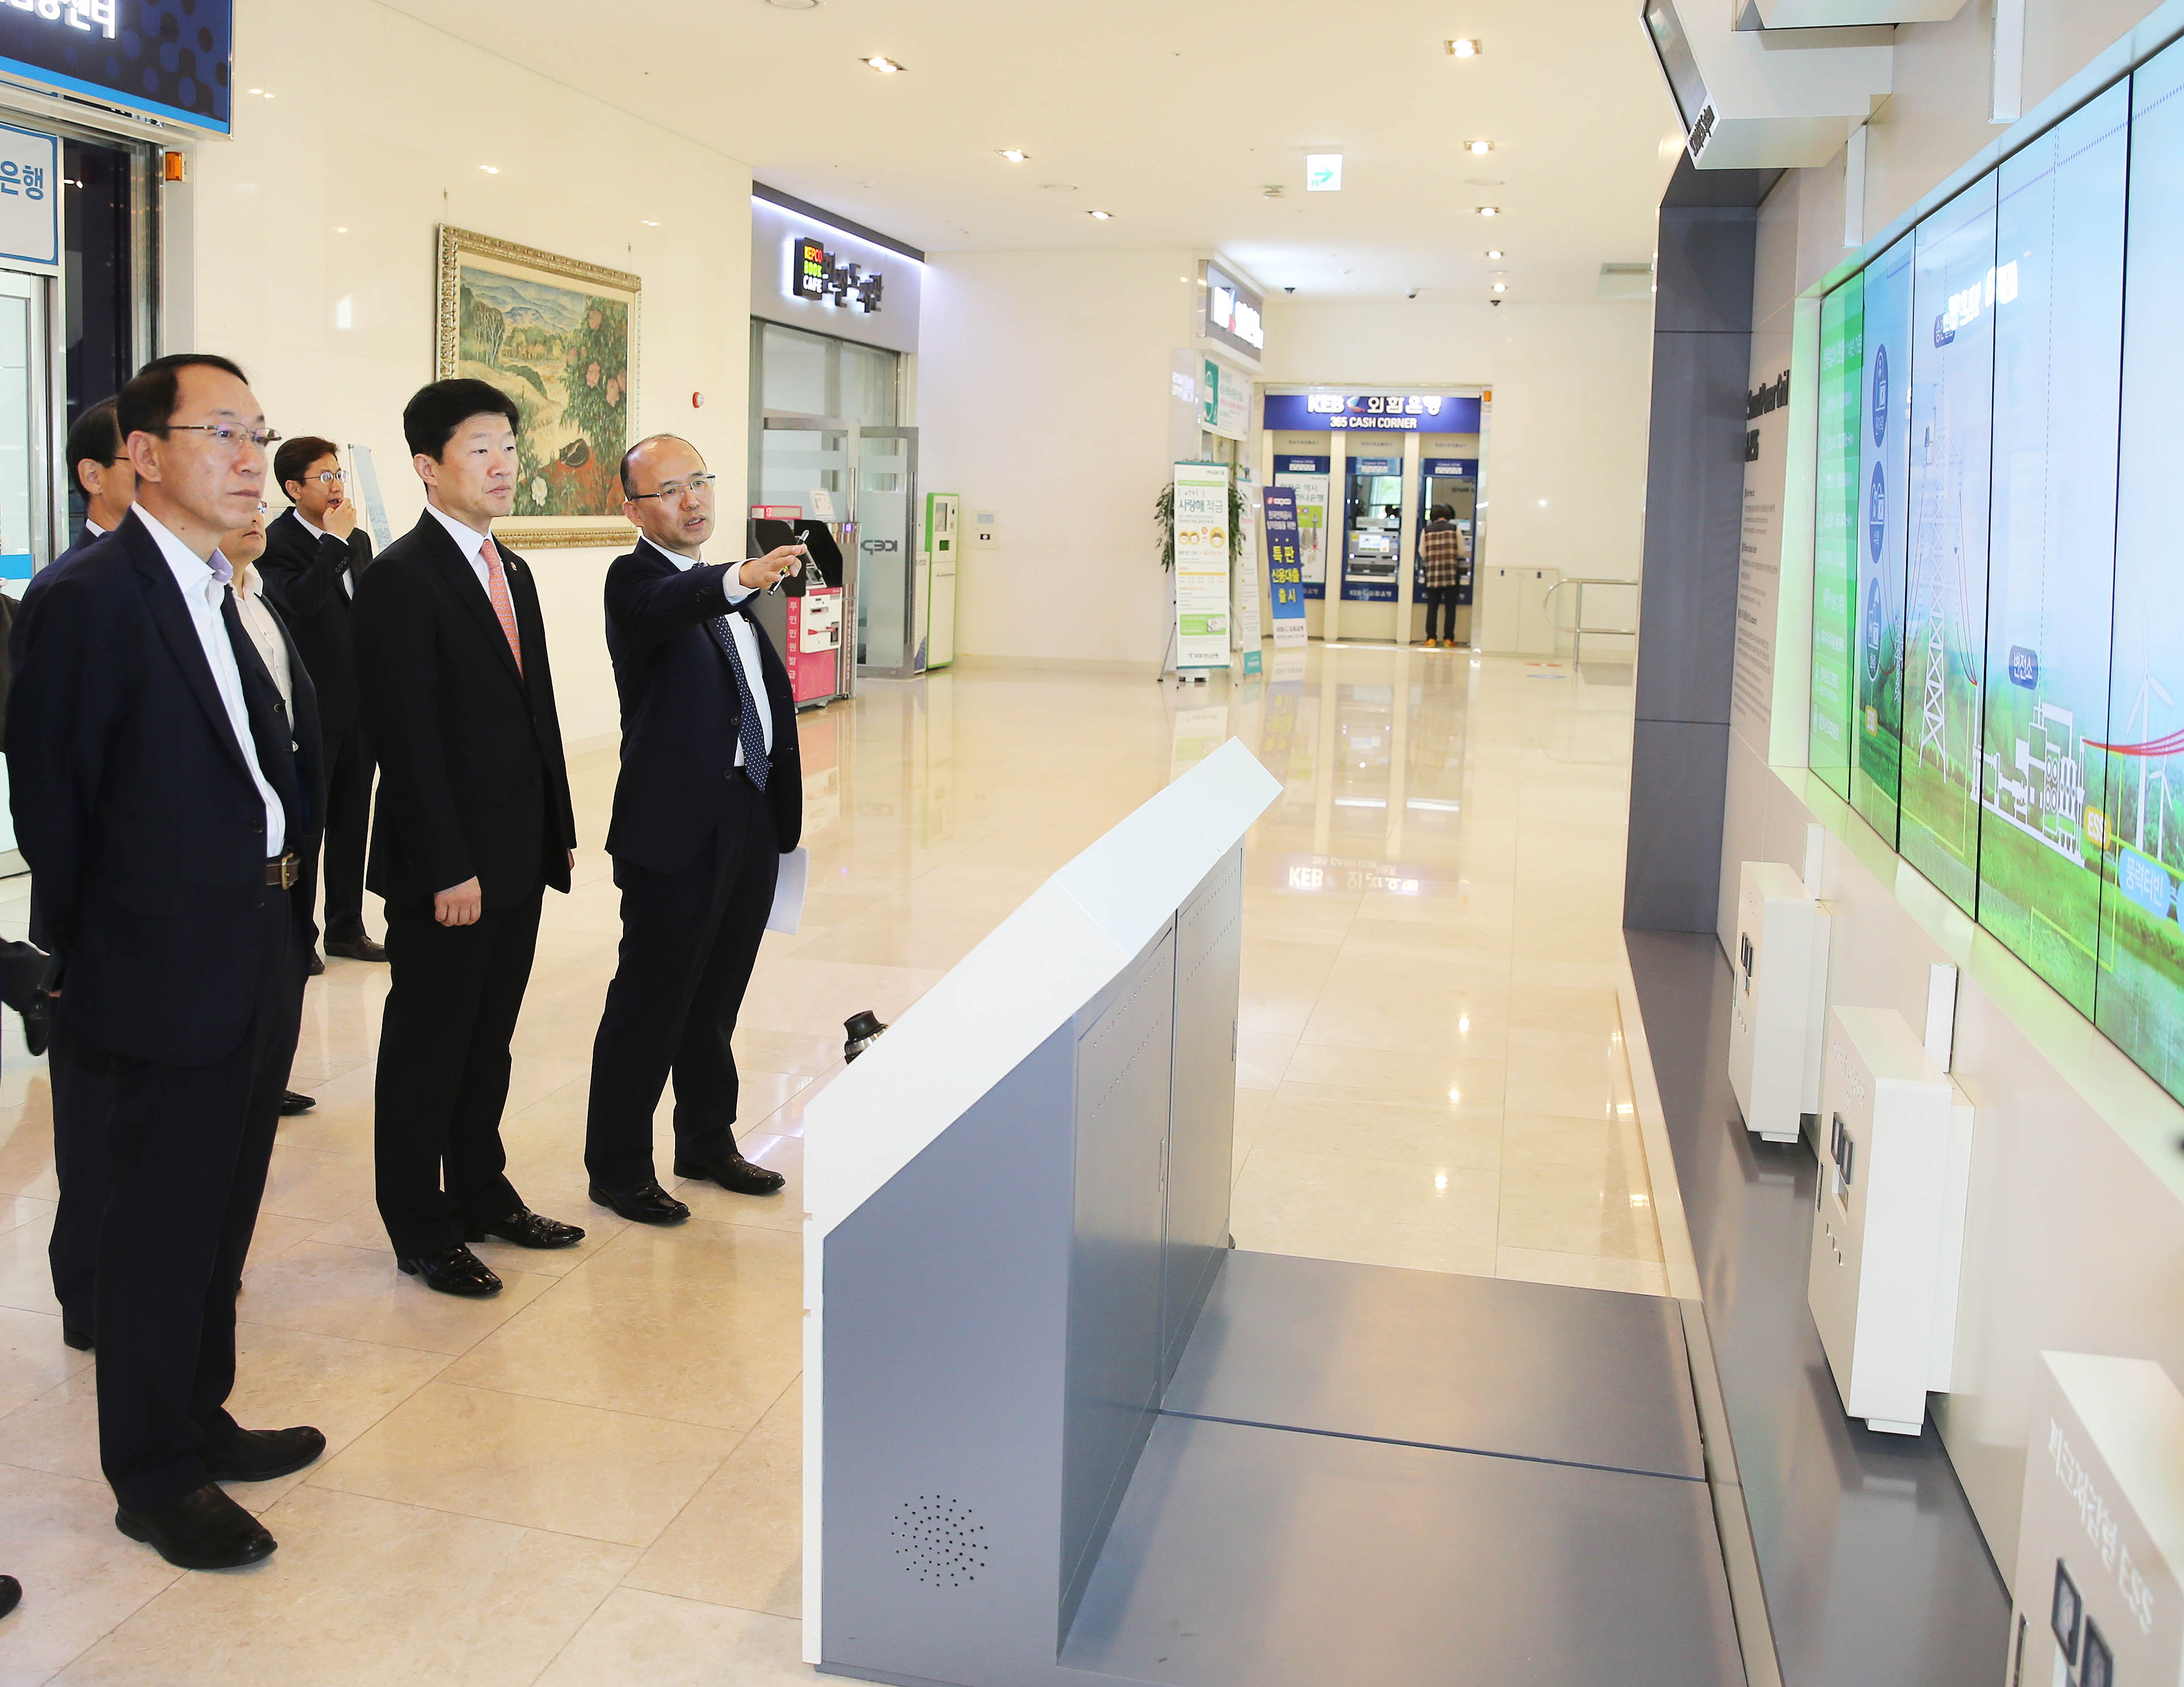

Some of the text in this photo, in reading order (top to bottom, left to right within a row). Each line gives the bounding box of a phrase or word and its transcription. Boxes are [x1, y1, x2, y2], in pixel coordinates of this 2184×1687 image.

[0, 160, 44, 201] 은행
[804, 245, 823, 263] KEPCO
[803, 260, 823, 278] BOOK
[802, 274, 823, 293] CAFE
[1307, 395, 1442, 416] KEB 외환은행
[1330, 416, 1417, 429] 365 CASH CORNER
[2013, 651, 2033, 681] 변전소
[2126, 856, 2163, 907] 풍력터빈
[2118, 1543, 2154, 1635] ESS
